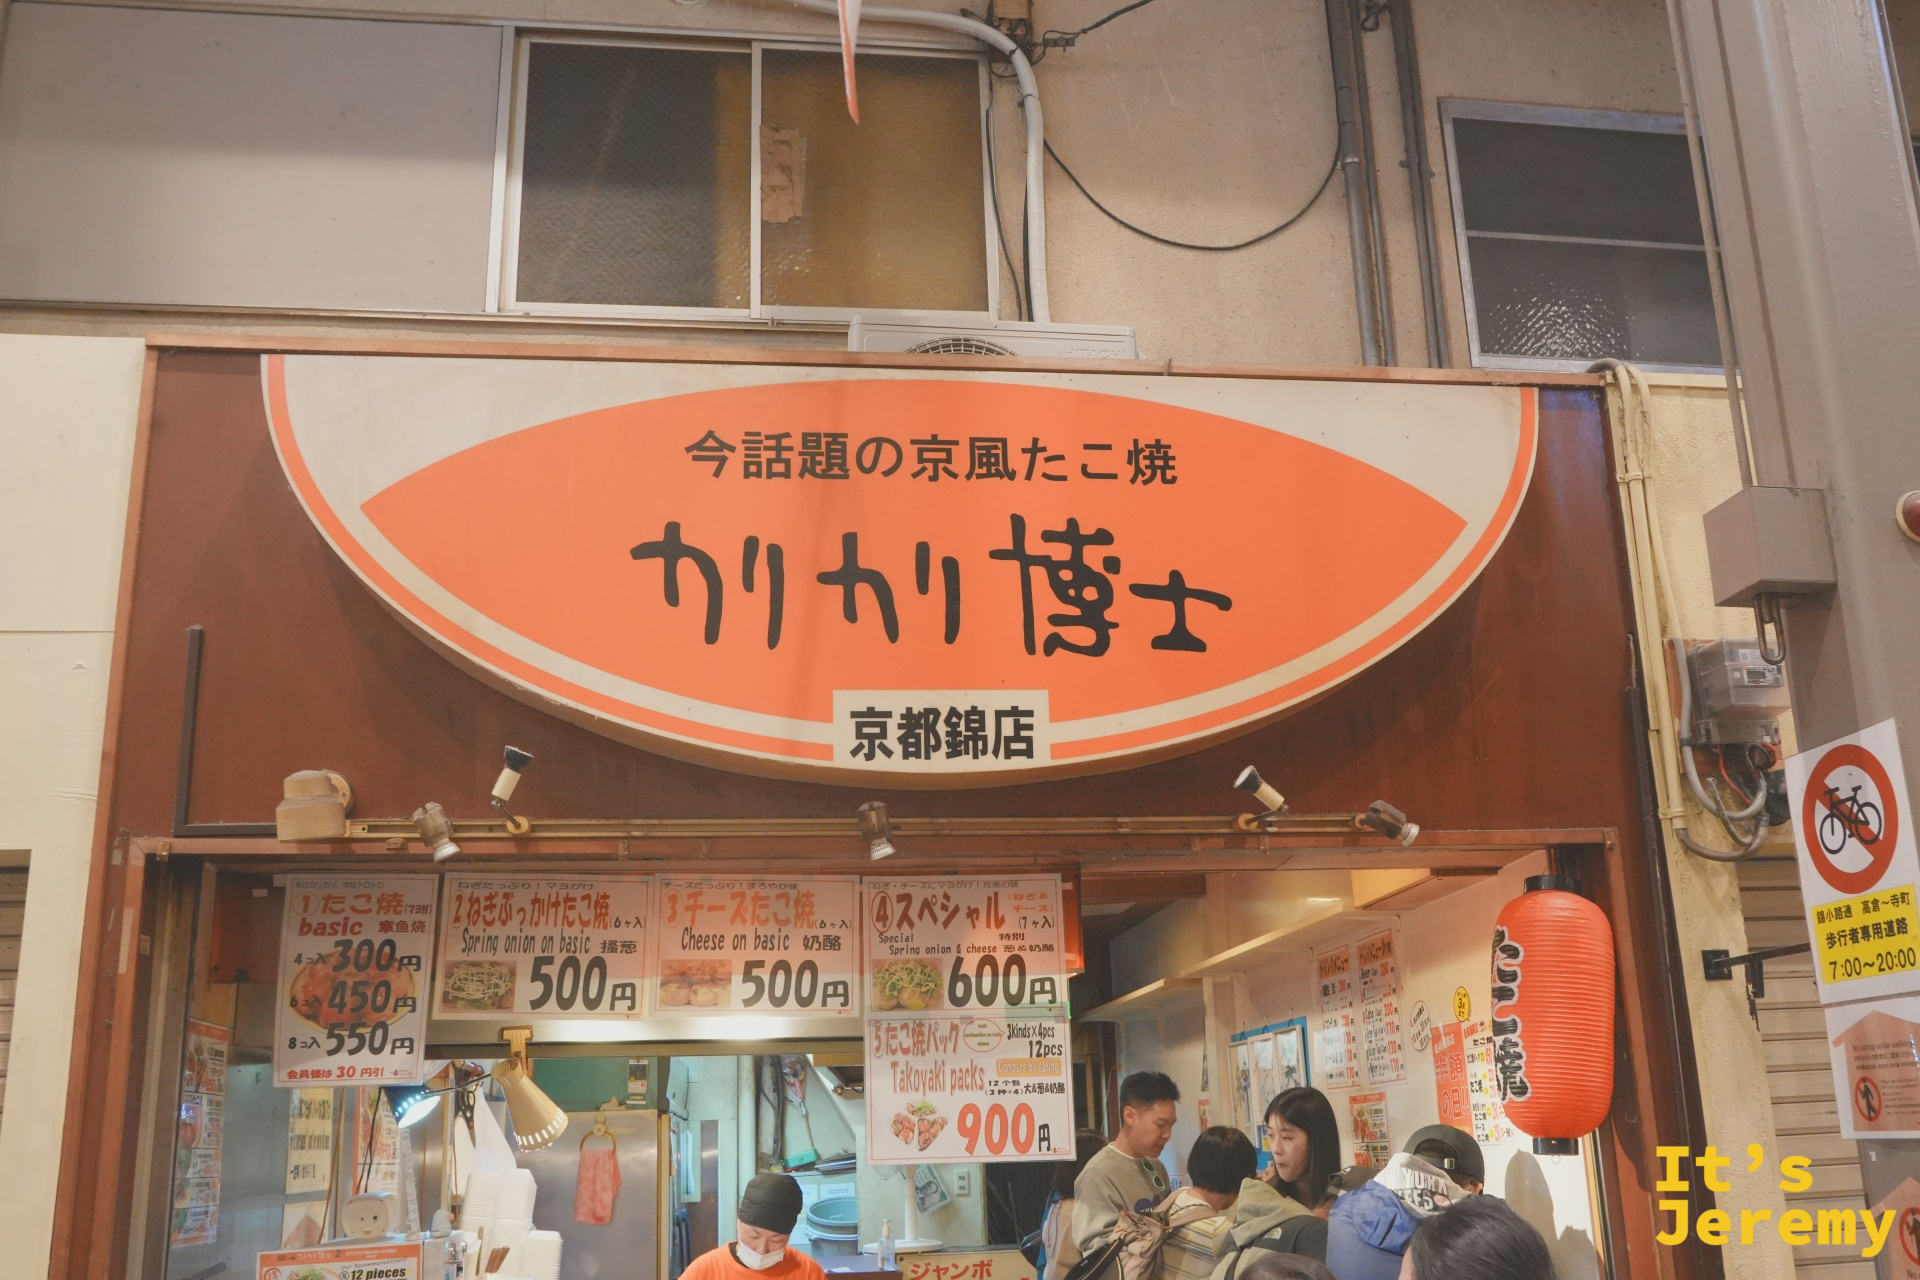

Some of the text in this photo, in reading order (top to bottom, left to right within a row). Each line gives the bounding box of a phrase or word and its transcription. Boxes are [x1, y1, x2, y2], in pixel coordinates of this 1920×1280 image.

[684, 429, 1178, 486] 今話題の京風たこ焼
[849, 705, 1035, 762] 京都錦店
[298, 917, 363, 936] basic
[1816, 904, 1853, 925] 錦小路通
[461, 927, 591, 956] Spring onion on basic
[681, 926, 790, 951] Cheese on basic
[802, 934, 842, 951] 奶酪
[878, 933, 914, 944] Special
[998, 932, 1025, 941] 特別
[1825, 917, 1908, 949] 歩行者専用道路
[333, 938, 421, 973] 300円
[889, 944, 920, 956] Spring
[925, 944, 951, 954] onion
[966, 943, 997, 953] cheese
[528, 955, 637, 1012] 500円
[741, 959, 850, 1008] 500円
[947, 953, 1057, 1007] 600円
[327, 980, 417, 1015] 450円
[326, 1020, 415, 1056] 550円
[1028, 1040, 1063, 1058] 12pcs
[950, 1058, 985, 1096] packs
[1435, 1052, 1464, 1084] 半額
[957, 1102, 1051, 1155] 900円
[351, 1270, 364, 1280] 12
[366, 1267, 406, 1280] pieces
[910, 1258, 993, 1280] ジャンボ
